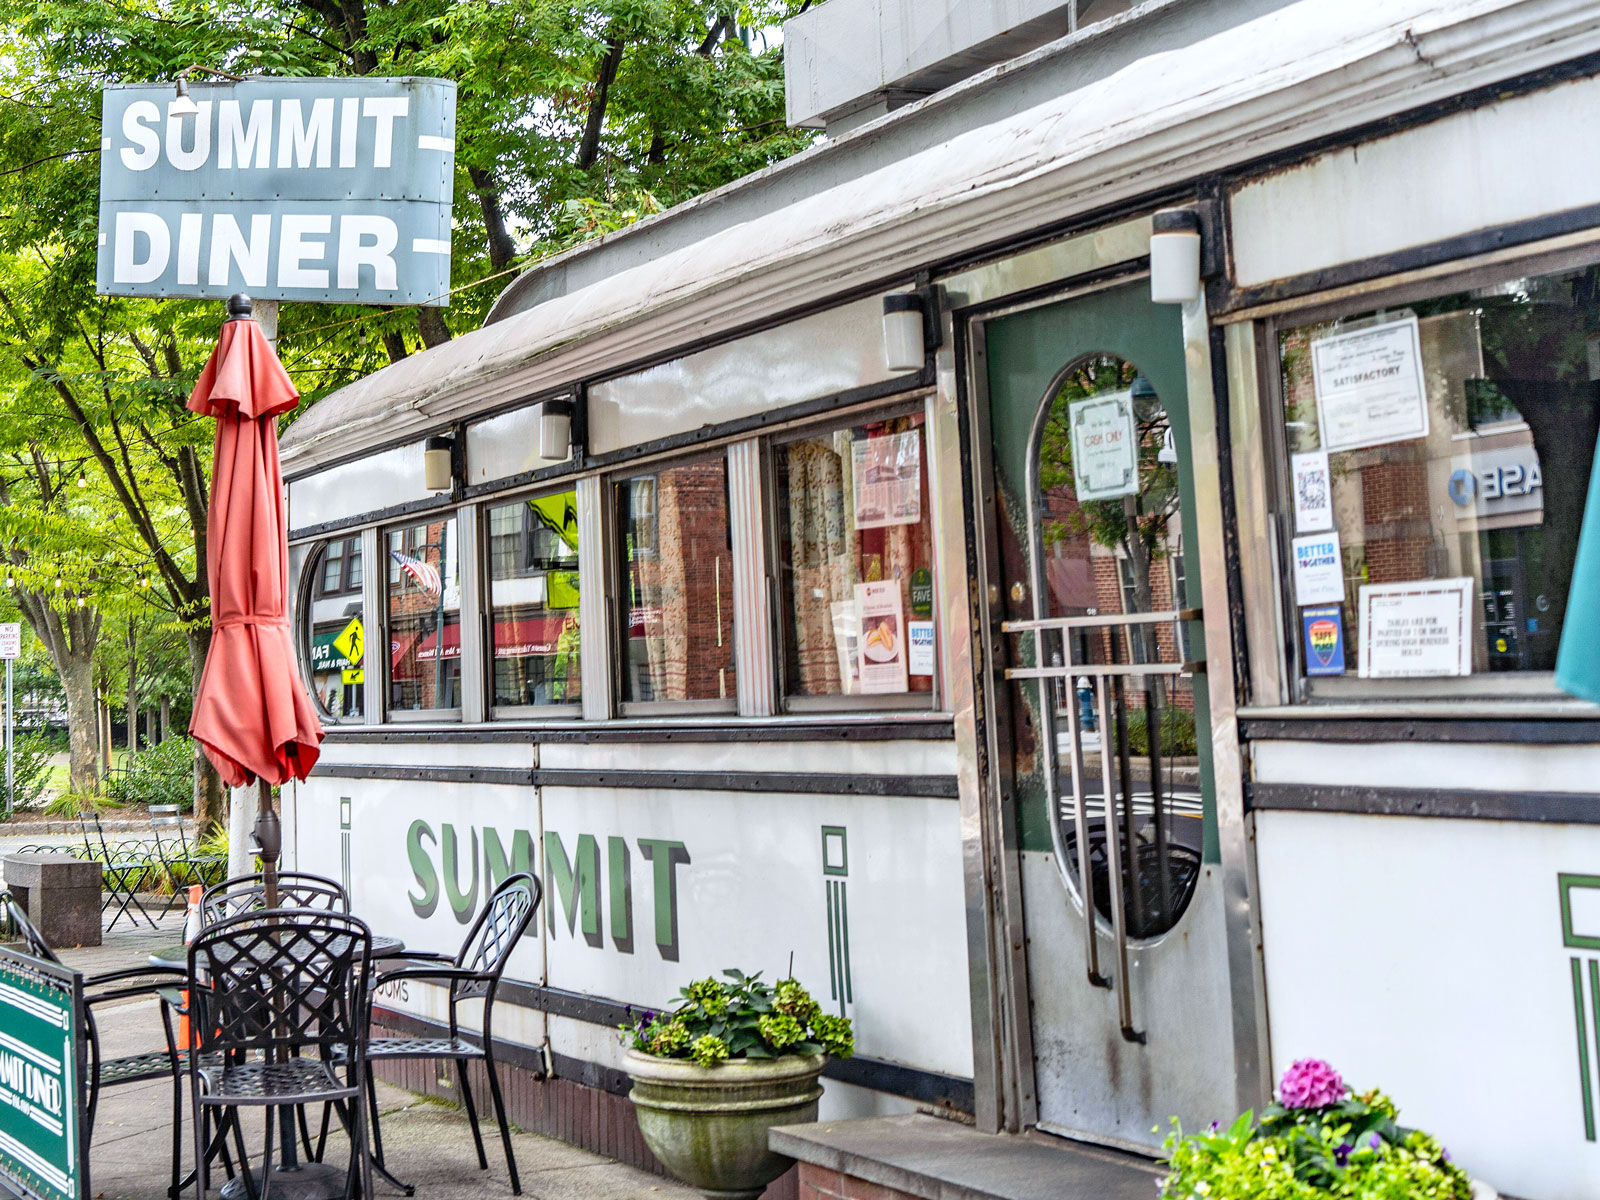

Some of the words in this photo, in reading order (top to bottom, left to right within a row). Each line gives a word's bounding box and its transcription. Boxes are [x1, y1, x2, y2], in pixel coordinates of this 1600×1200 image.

[120, 96, 409, 171] SUMMIT
[114, 212, 399, 291] DINER
[1333, 366, 1401, 388] SATISFACTORY
[1084, 434, 1104, 448] CASH
[1105, 430, 1122, 444] ONLY
[1297, 543, 1334, 558] BETTER
[1299, 557, 1335, 568] TOGETHER
[913, 590, 931, 602] FAVE
[406, 818, 691, 962] SUMMIT
